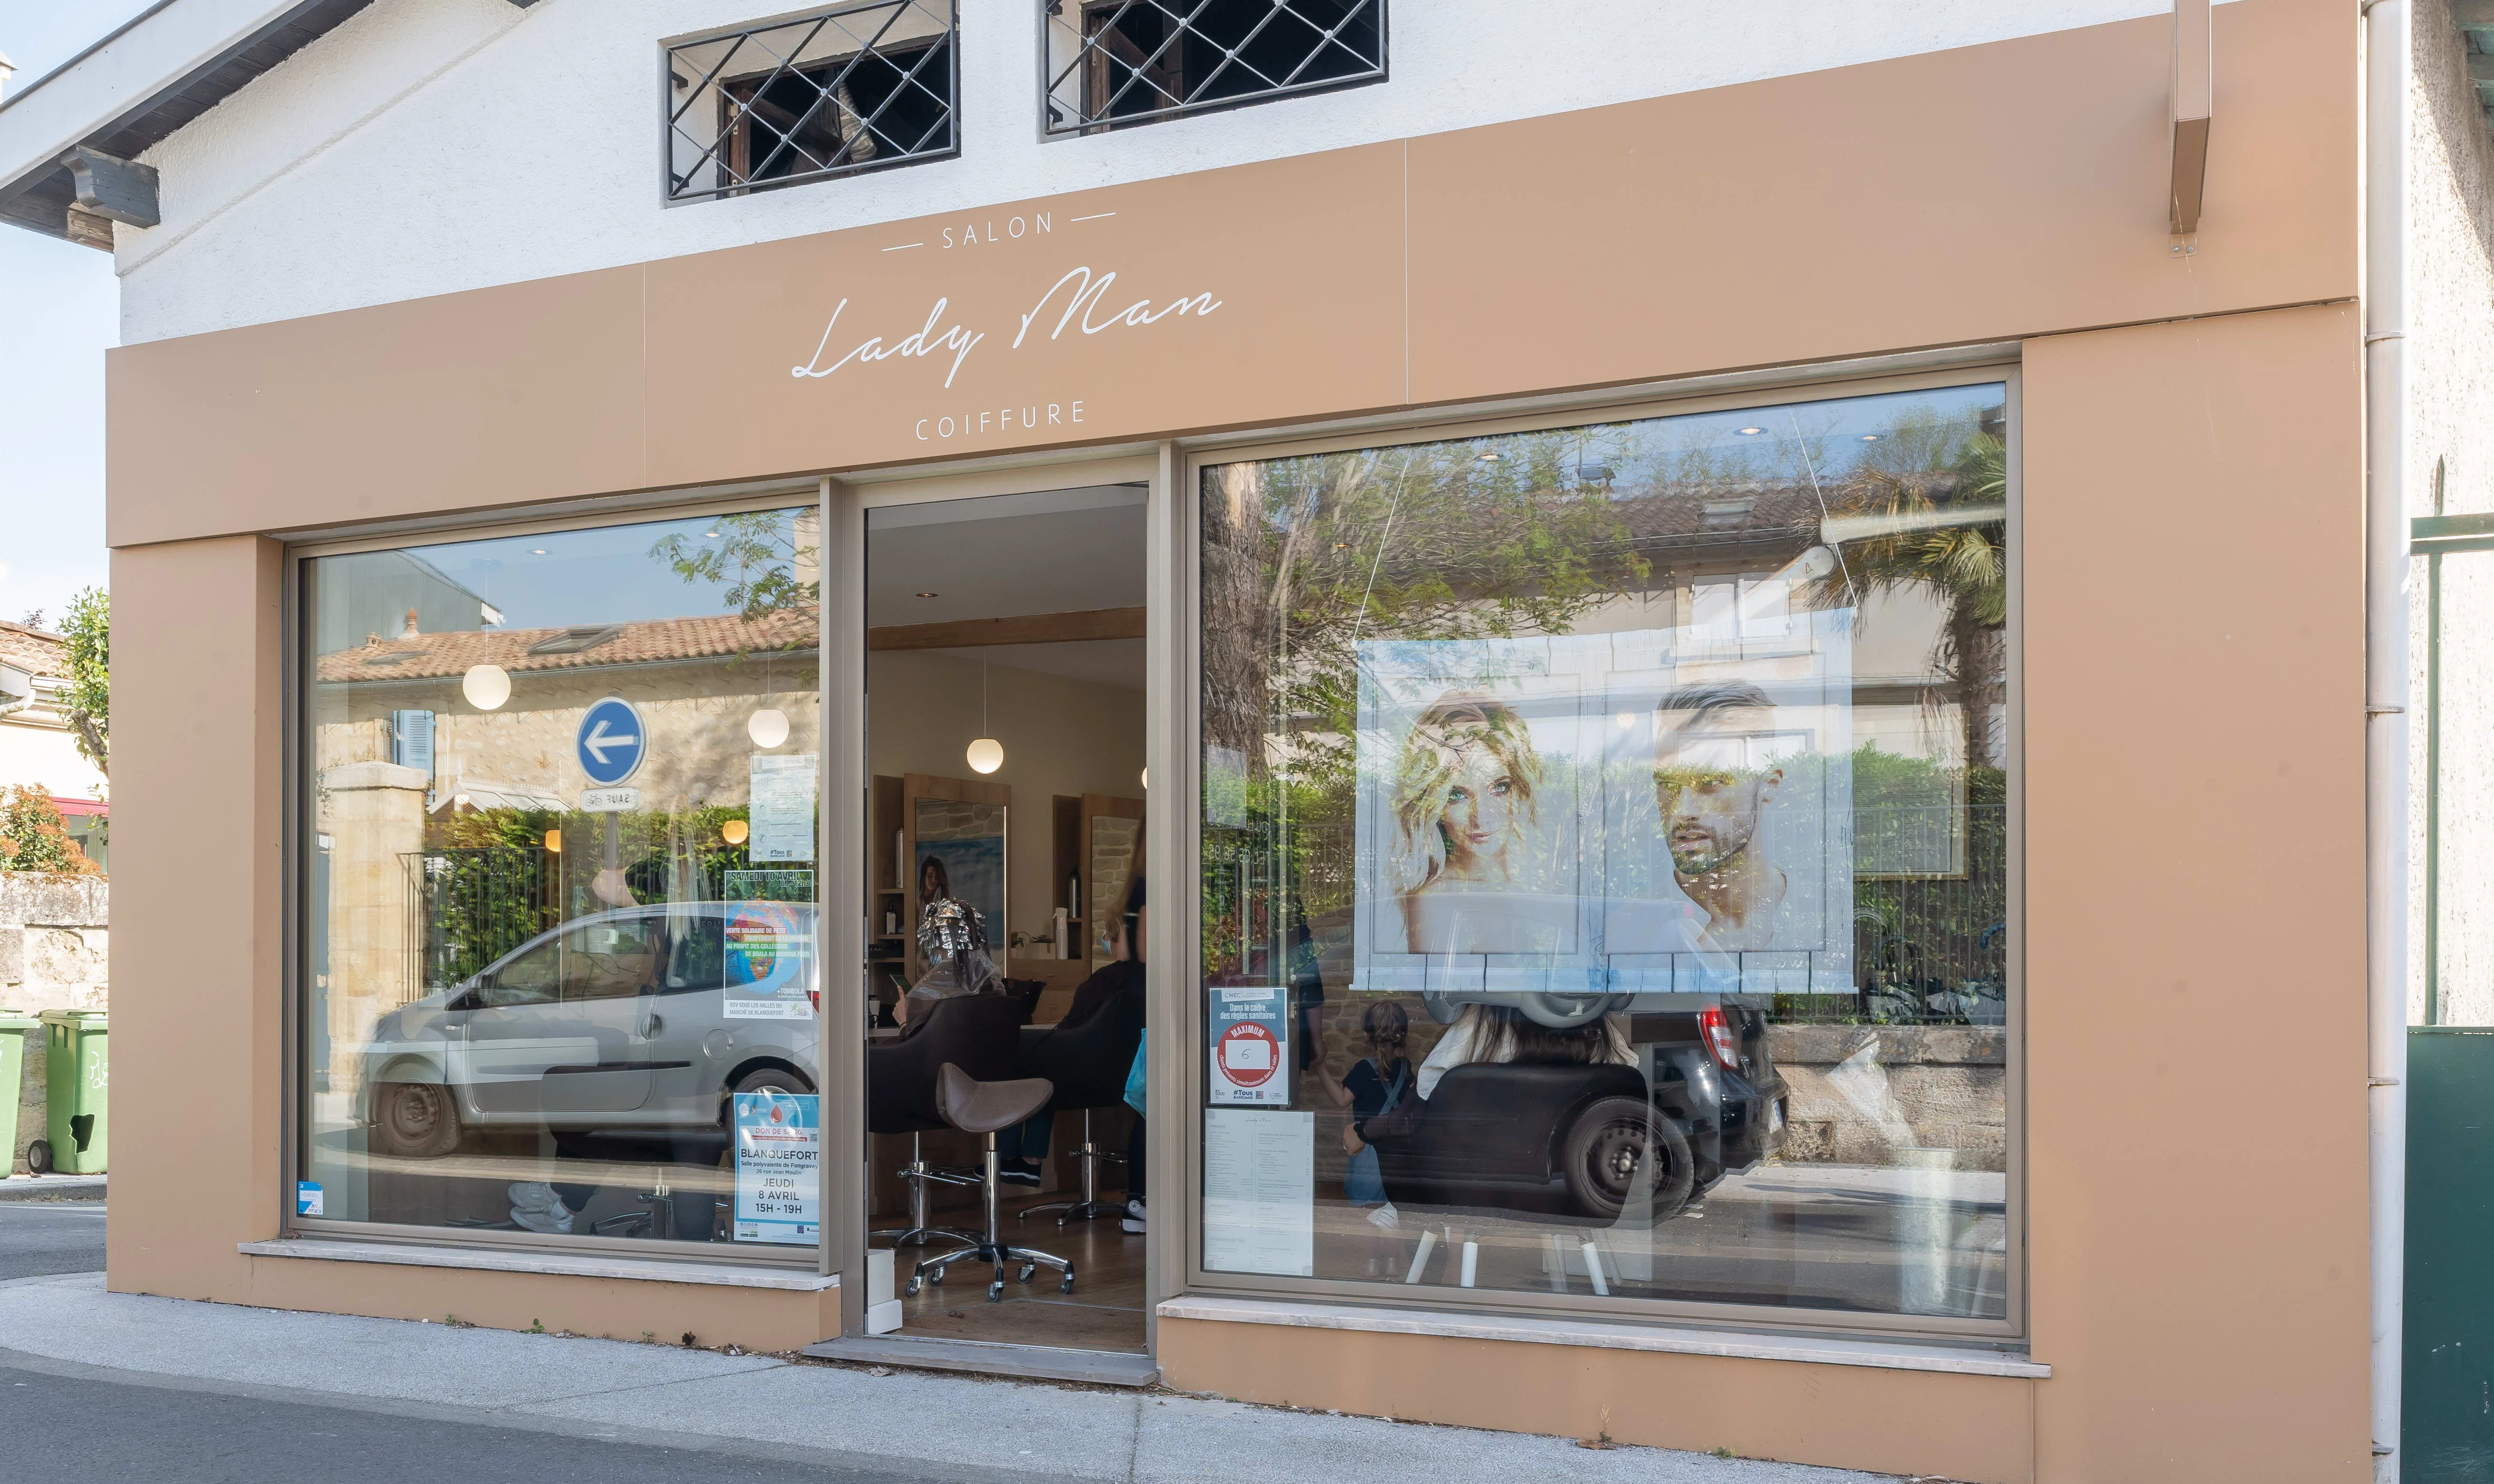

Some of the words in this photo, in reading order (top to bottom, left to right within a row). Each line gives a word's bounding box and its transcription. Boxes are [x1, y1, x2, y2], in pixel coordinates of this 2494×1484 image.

[943, 212, 1052, 249] SALON
[792, 297, 984, 389] Lady
[1012, 266, 1223, 349] Man
[916, 400, 1084, 441] COIFFURE
[730, 871, 763, 881] SAMEDI
[765, 871, 777, 881] 10
[777, 871, 802, 881] AVRIL
[1244, 1003, 1249, 1011] le
[1250, 1003, 1266, 1011] cadre
[1220, 1011, 1230, 1019] des
[1231, 1011, 1248, 1020] règles
[1249, 1011, 1276, 1019] sanitaires
[1231, 1025, 1265, 1038] MAXIMUM
[1242, 1048, 1251, 1059] 6
[1222, 1068, 1236, 1082] présents
[1236, 1077, 1265, 1086] simultanément
[1264, 1070, 1273, 1079] dans
[741, 1149, 818, 1160] BLANQUEFORT
[763, 1178, 793, 1187] JEUDI
[759, 1190, 764, 1199] 8
[768, 1191, 800, 1200] AVRIL
[756, 1203, 773, 1212] 15H
[783, 1205, 802, 1214] 19H
